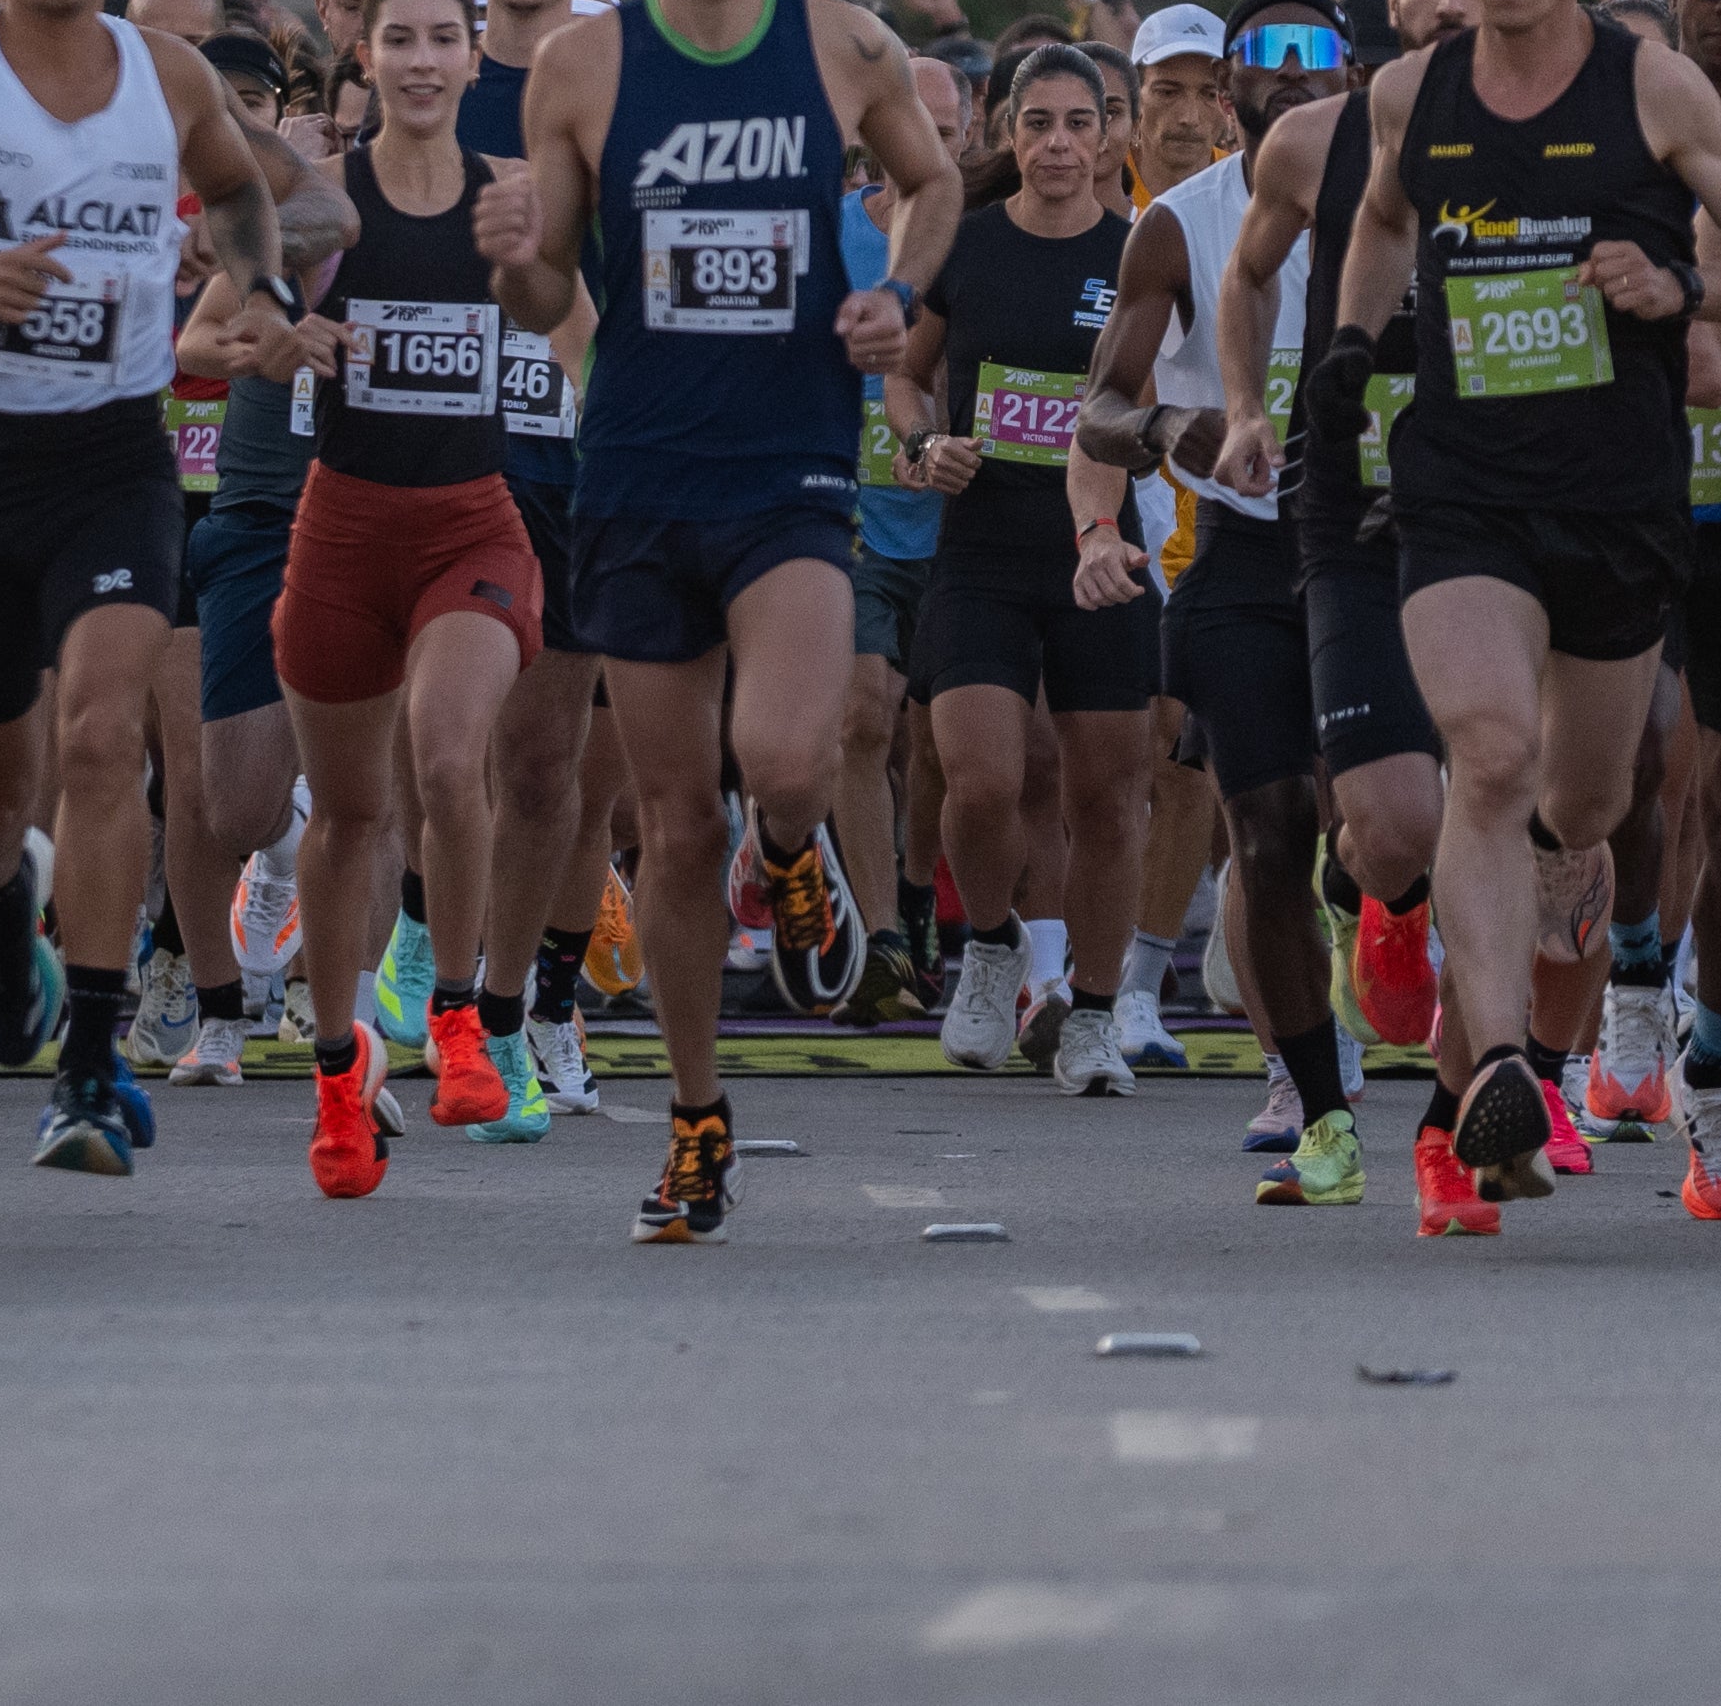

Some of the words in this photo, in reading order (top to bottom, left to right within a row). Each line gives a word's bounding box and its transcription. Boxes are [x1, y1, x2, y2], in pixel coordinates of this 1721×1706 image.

[21, 230, 161, 255] EMEENDIMENTOS
[1476, 255, 1505, 268] PARTE
[1506, 254, 1538, 266] DESTA
[1538, 252, 1574, 265] EQUIPE
[692, 247, 778, 294] 893
[705, 295, 760, 308] JONATHAN
[18, 296, 106, 347] 558
[1480, 303, 1590, 355] 2693
[381, 332, 481, 377] 1656
[353, 370, 367, 382] 7K
[501, 359, 551, 400] 46
[298, 377, 310, 394] A
[297, 403, 310, 414] 7K
[979, 397, 991, 415] A
[1000, 393, 1083, 434] 2122
[1021, 432, 1057, 445] VICTORIA
[801, 474, 848, 491] ALWAYS
